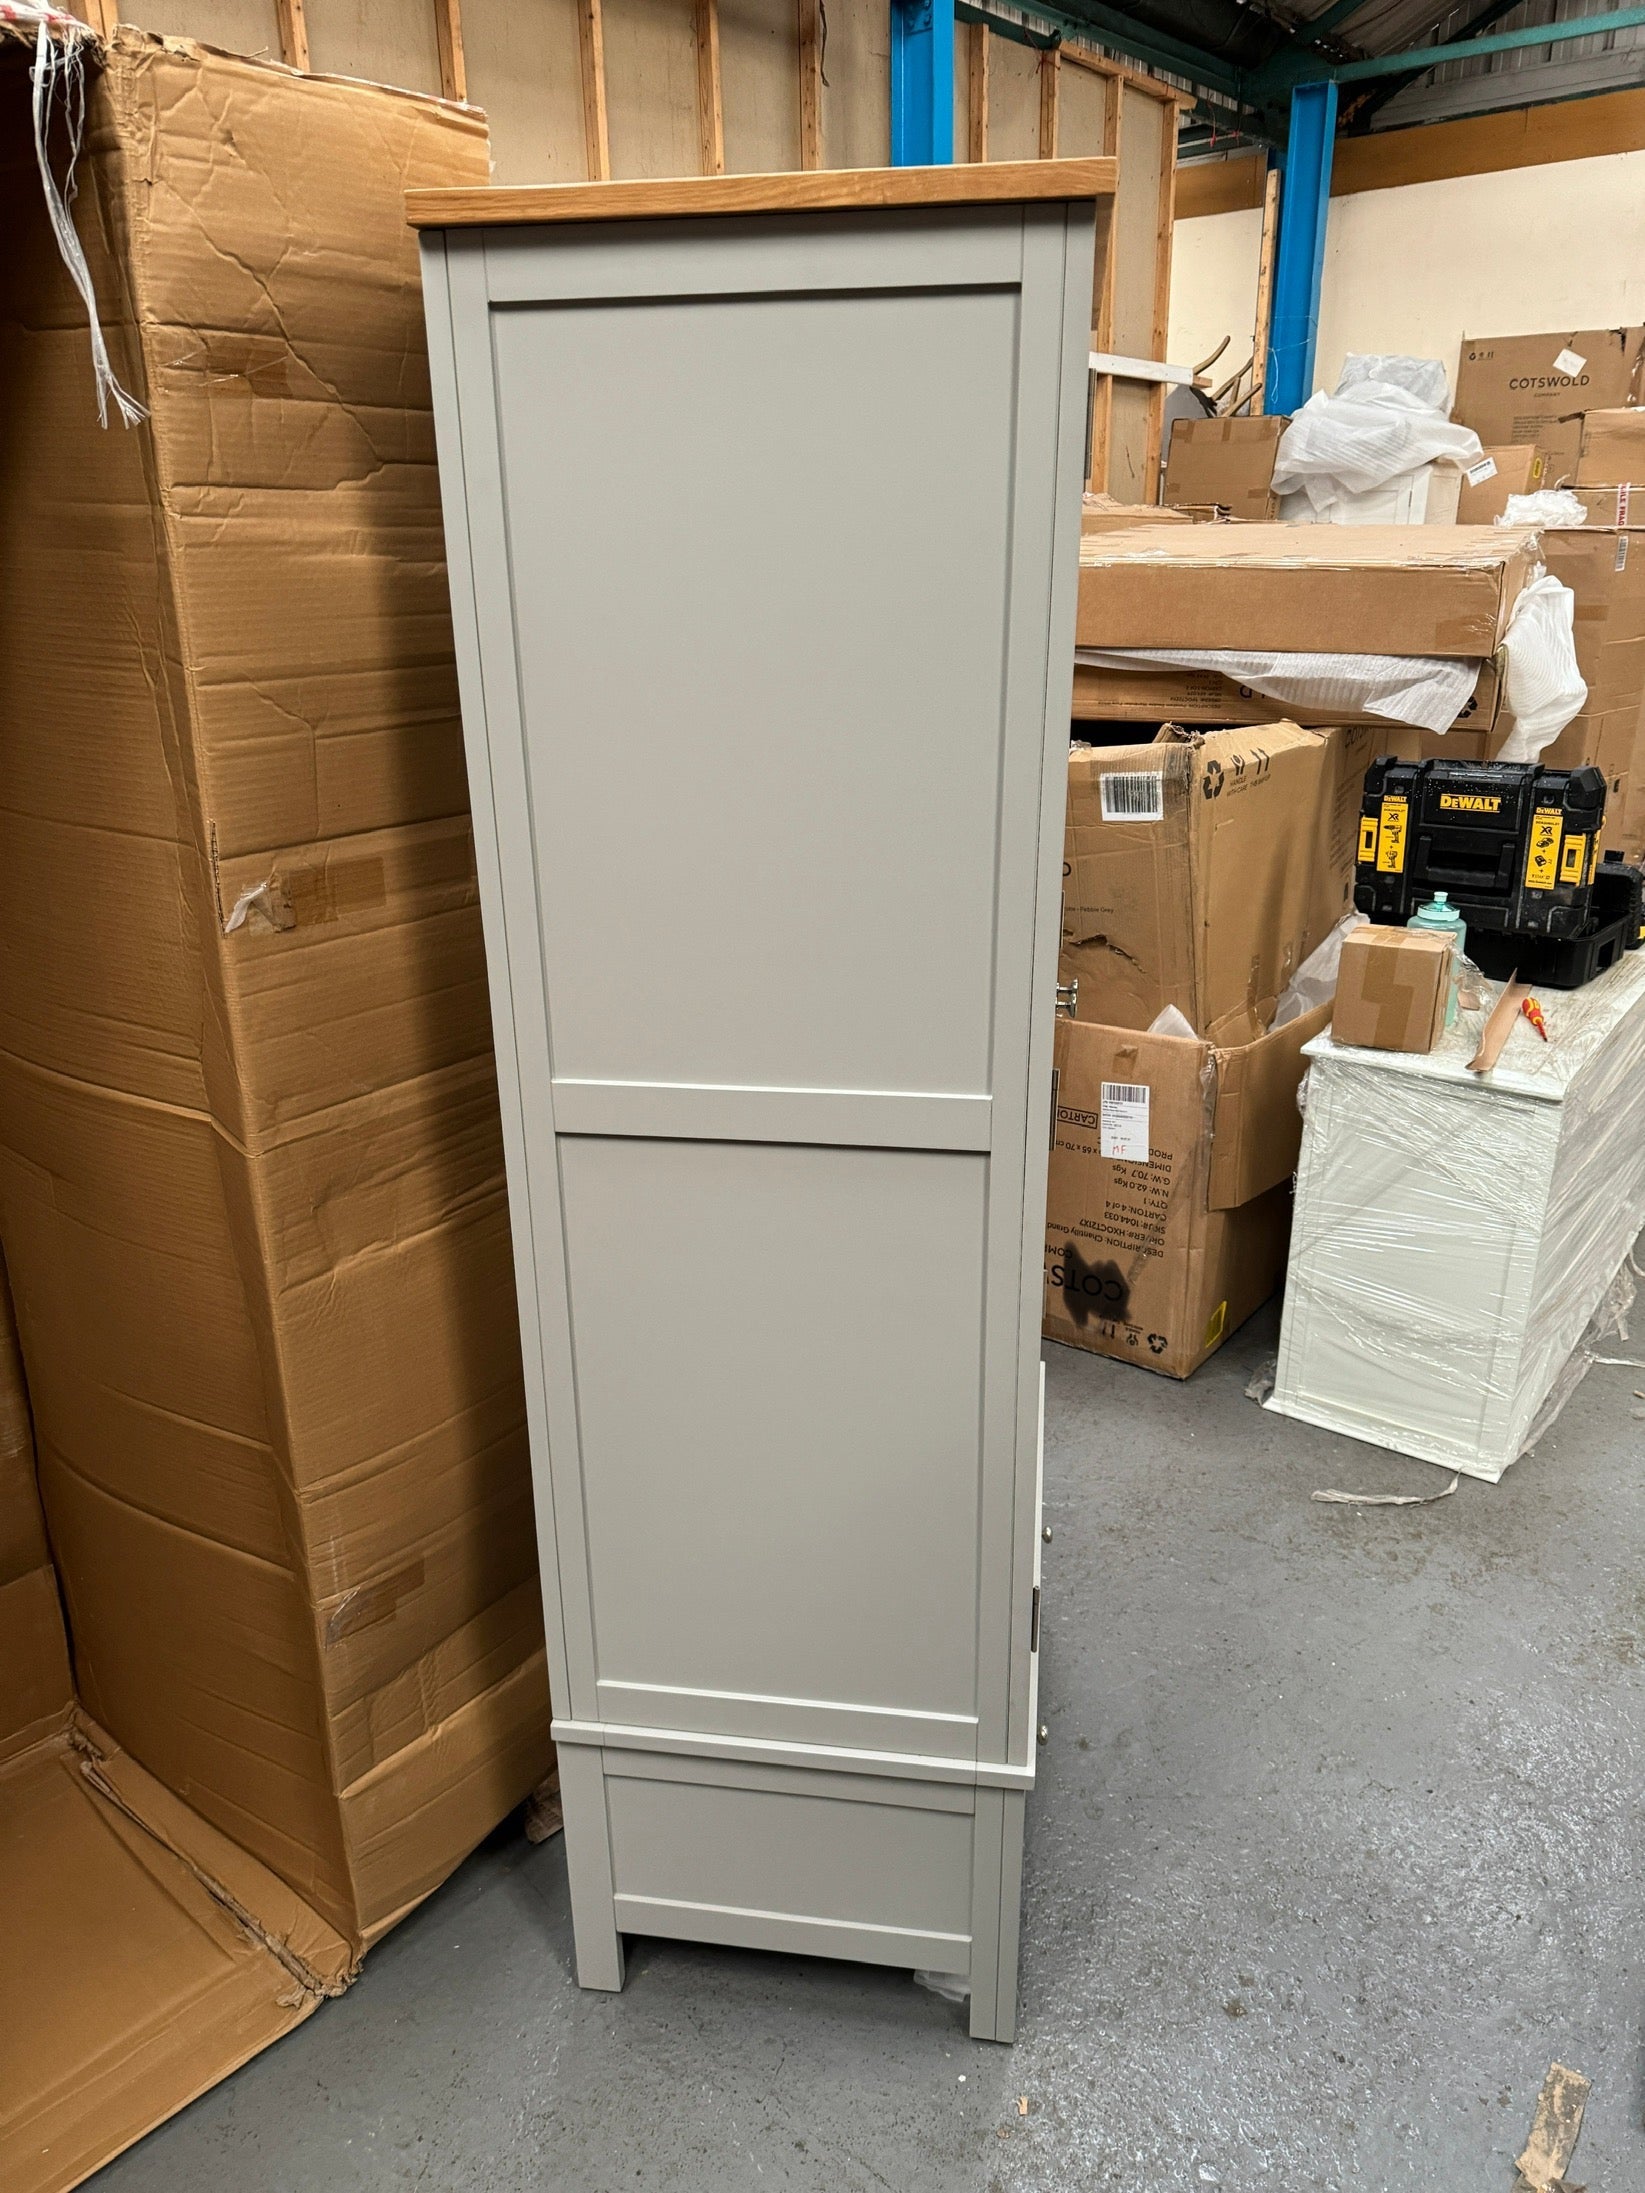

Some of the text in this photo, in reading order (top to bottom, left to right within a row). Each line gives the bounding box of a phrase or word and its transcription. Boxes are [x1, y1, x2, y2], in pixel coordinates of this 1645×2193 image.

[1509, 375, 1590, 390] COTSWOLD
[1065, 1142, 1076, 1151] 70
[1082, 1145, 1092, 1154] 65
[1112, 1165, 1127, 1175] Kgs
[1131, 1169, 1148, 1180] 70.7
[1114, 1177, 1128, 1188] Kgs
[1129, 1183, 1148, 1193] 62.0
[1105, 1200, 1111, 1208] 4
[1121, 1204, 1127, 1212] 4
[1104, 1211, 1140, 1227] 1044.033
[1047, 1221, 1070, 1234] Grand
[1070, 1226, 1103, 1243] Chantilly
